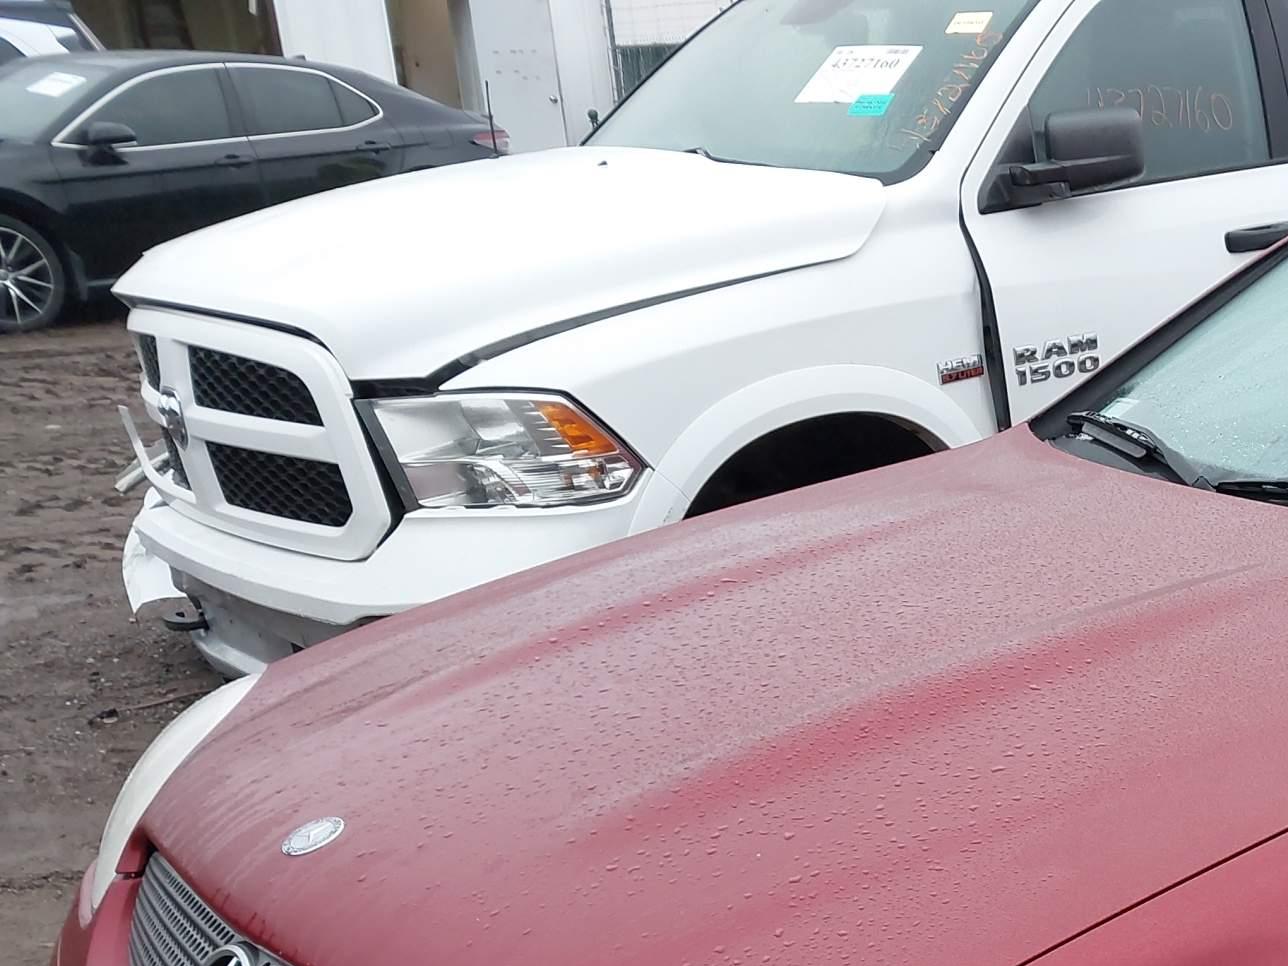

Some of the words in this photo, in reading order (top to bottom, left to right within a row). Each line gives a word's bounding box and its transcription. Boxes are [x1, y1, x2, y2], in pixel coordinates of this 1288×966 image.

[937, 353, 983, 373] HEMI
[1013, 333, 1098, 366] RAM
[1016, 353, 1100, 386] 1500
